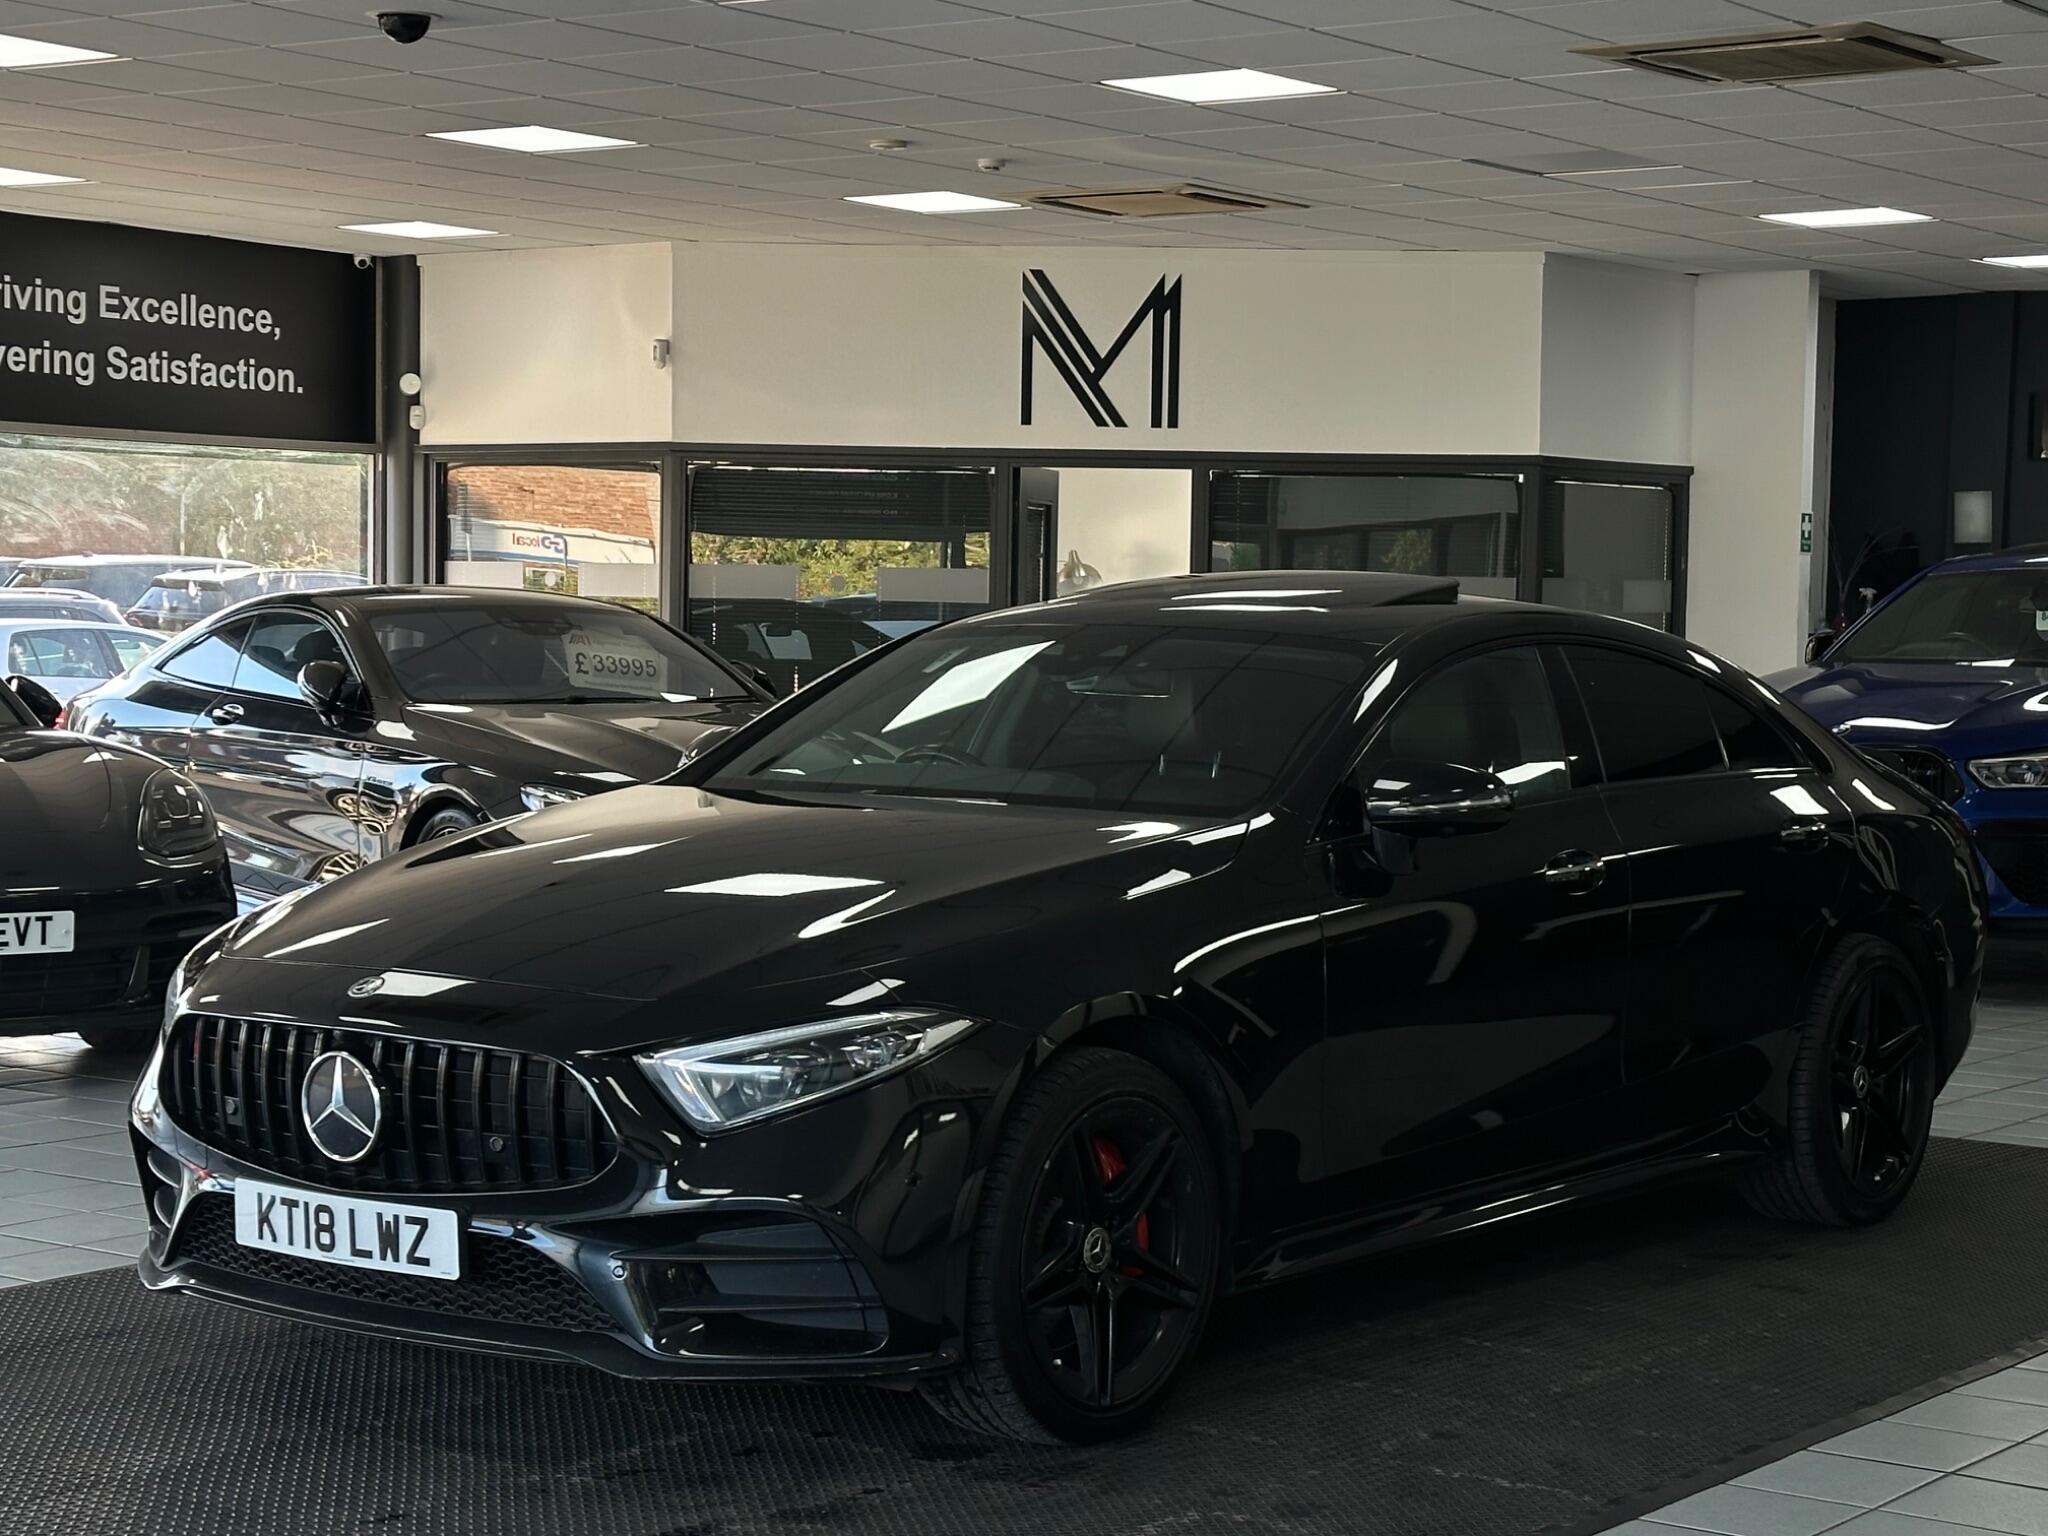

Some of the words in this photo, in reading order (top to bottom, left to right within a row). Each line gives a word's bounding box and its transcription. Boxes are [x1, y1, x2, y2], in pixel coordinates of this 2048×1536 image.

[0, 275, 87, 324] iving
[100, 284, 280, 341] Excellence,
[106, 345, 303, 394] Satisfaction.
[575, 652, 657, 677] £33995
[257, 1192, 335, 1252] KT18
[348, 1208, 430, 1266] LWZ
